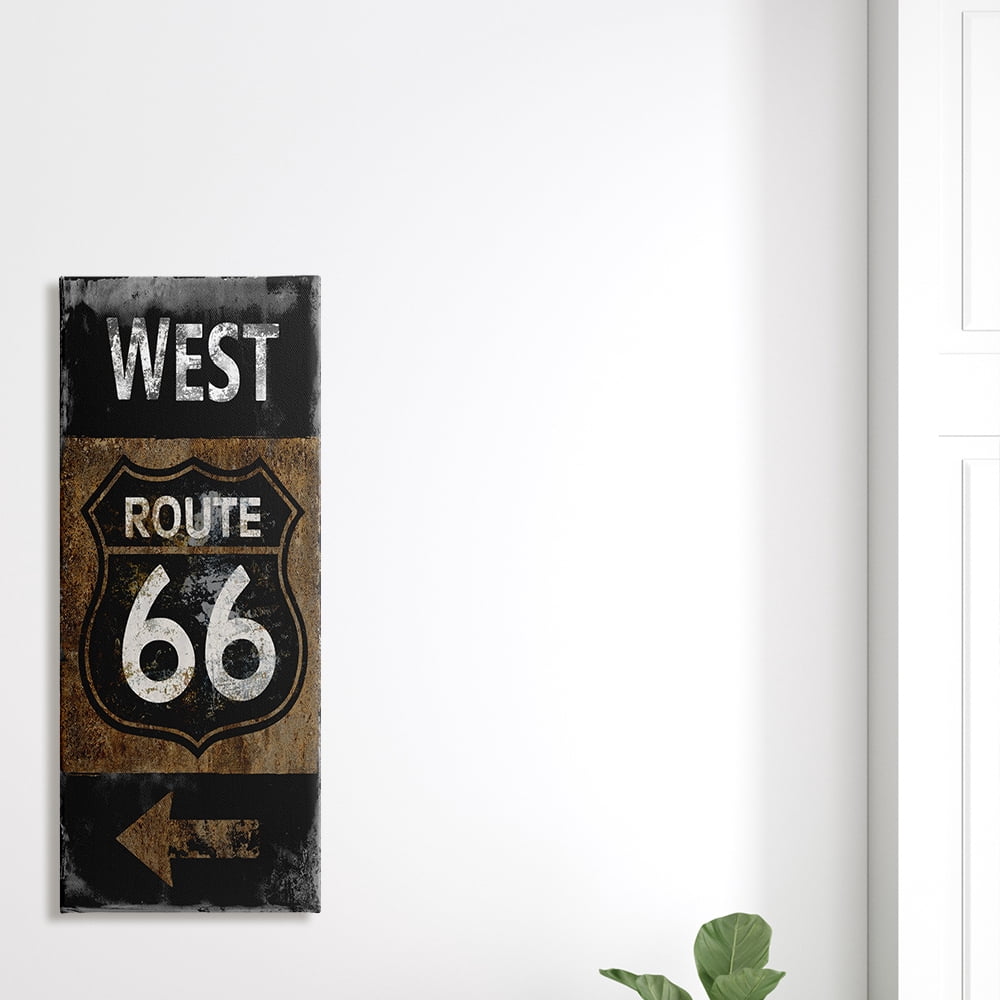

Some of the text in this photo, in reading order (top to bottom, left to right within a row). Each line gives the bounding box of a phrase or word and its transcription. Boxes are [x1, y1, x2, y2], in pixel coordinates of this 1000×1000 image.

[106, 316, 280, 403] WEST
[124, 495, 262, 539] ROUTE
[121, 564, 277, 704] 66
